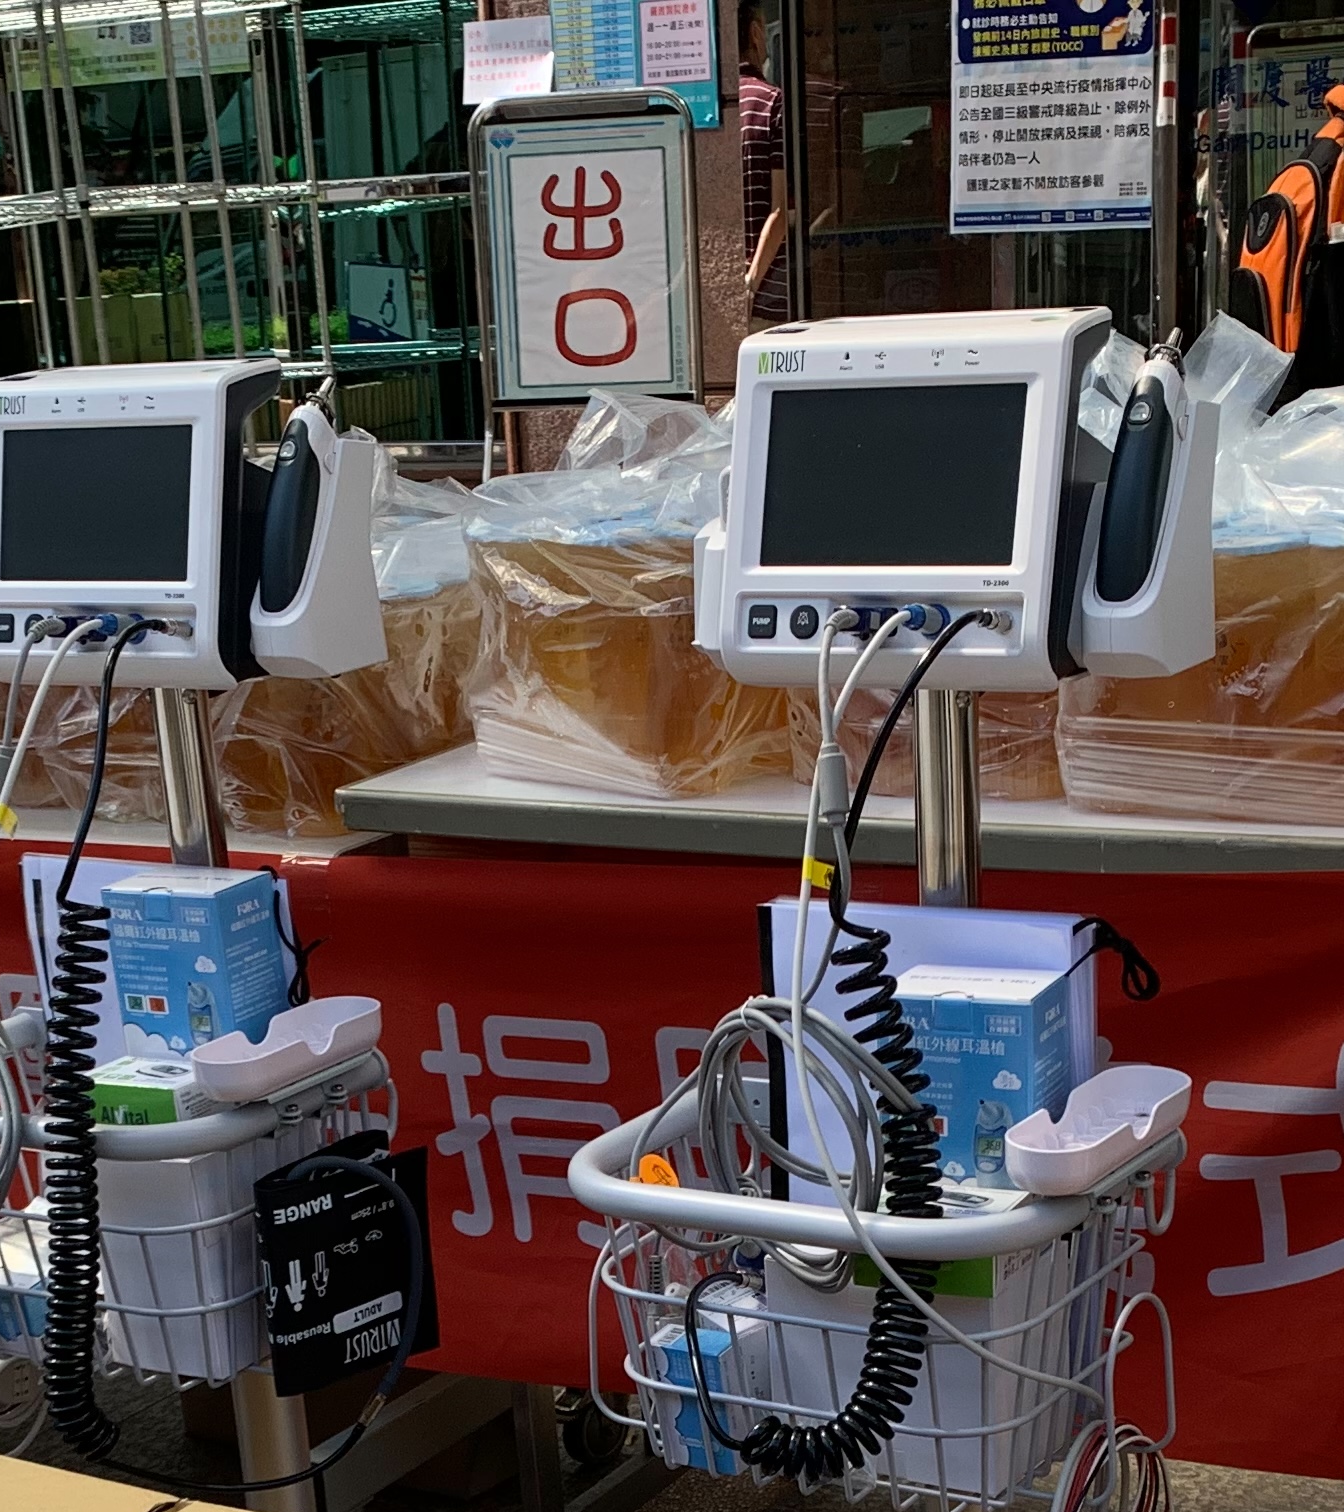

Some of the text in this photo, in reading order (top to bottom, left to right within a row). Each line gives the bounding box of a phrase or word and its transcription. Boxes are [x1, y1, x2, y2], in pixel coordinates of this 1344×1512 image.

[959, 76, 1152, 99] 即日起延長至中央流行疫情指揮中心
[958, 151, 1041, 167] 陪伴者仍為一人
[541, 166, 637, 368] 出口
[752, 616, 771, 626] PUMP
[914, 1037, 1006, 1056] 紅外線耳溫槍
[272, 1193, 333, 1225] RANGE
[353, 1302, 383, 1322] ADULT
[275, 1321, 332, 1346] Reusable
